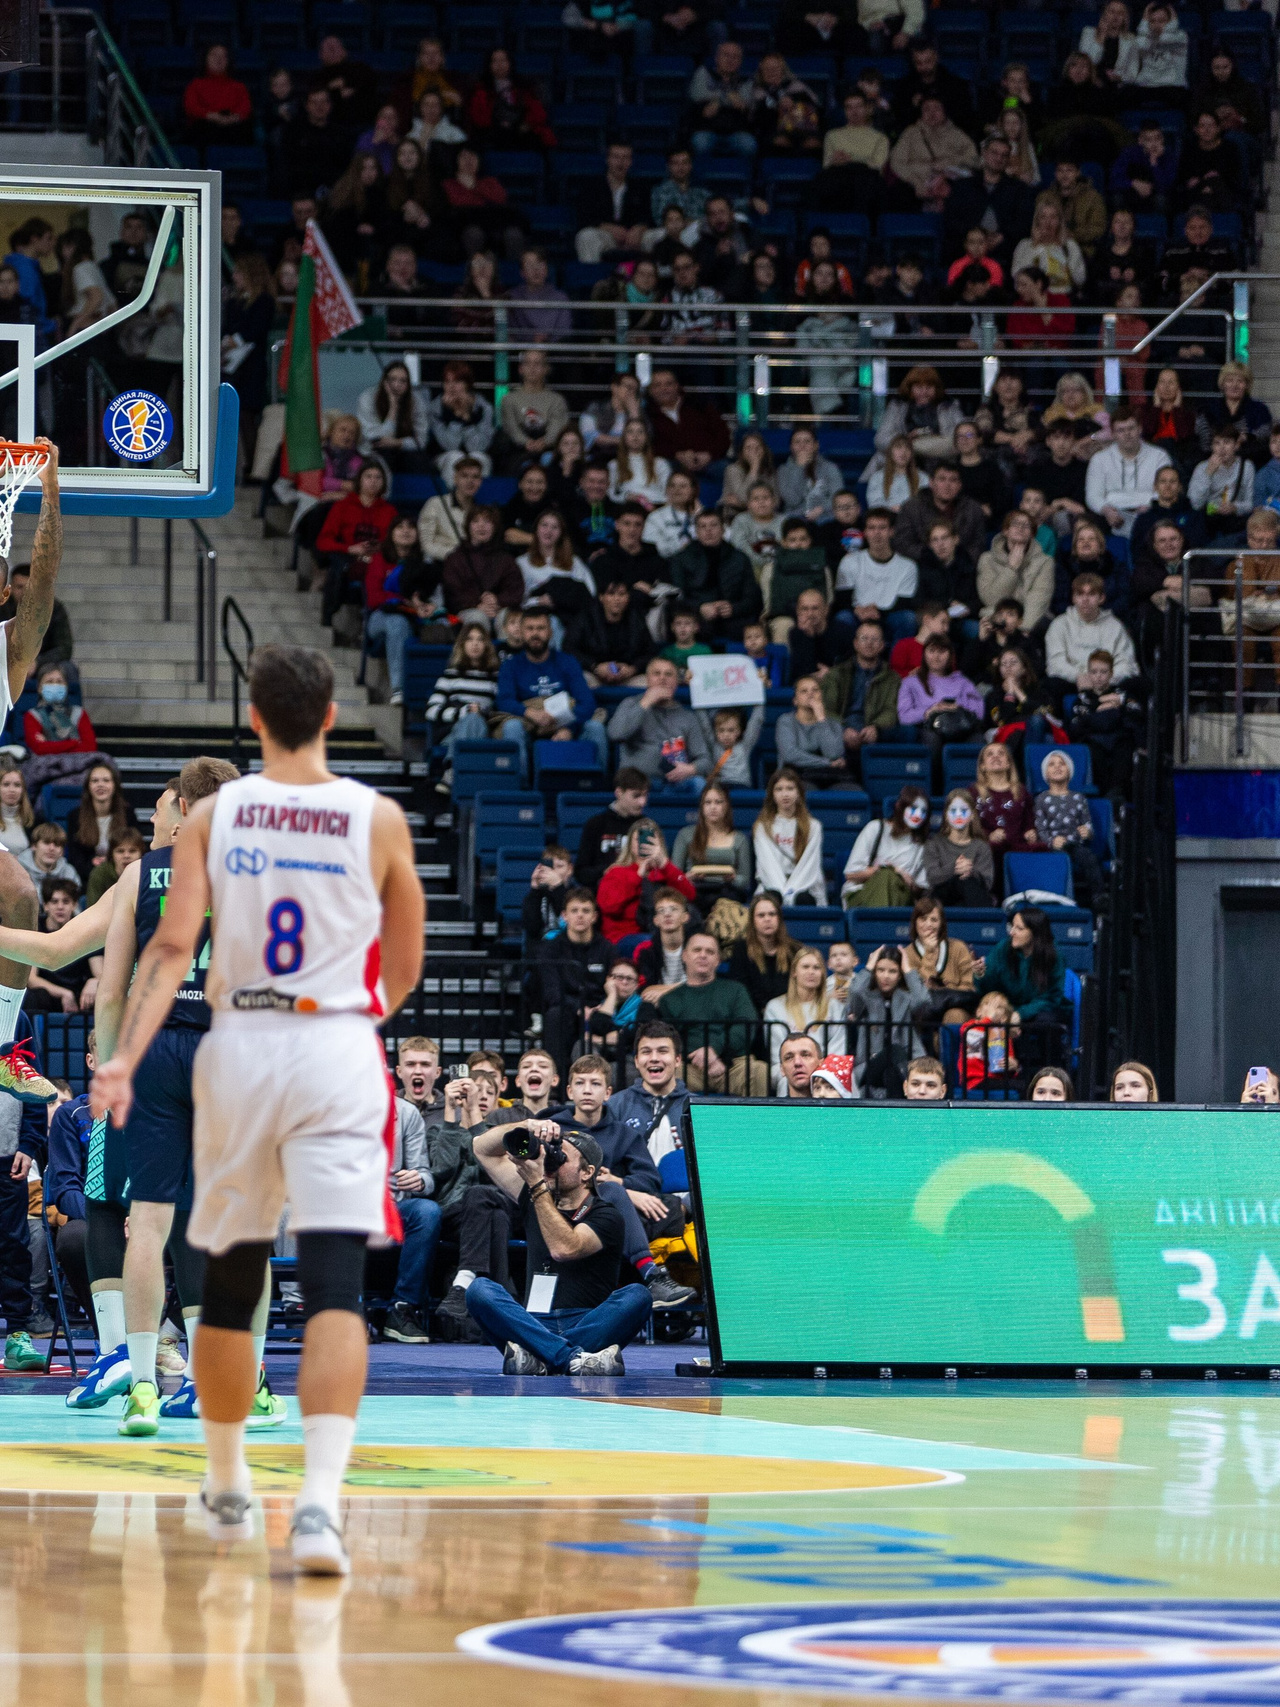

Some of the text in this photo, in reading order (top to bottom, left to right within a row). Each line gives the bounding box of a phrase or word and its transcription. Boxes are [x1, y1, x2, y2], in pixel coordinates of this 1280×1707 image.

[109, 392, 168, 414] ЕДИНАЯ ЛИГА ВТБ
[109, 437, 168, 460] VTB UNITED LEAGUE
[233, 804, 350, 838] ASTAPKOVICH
[262, 896, 305, 977] 8
